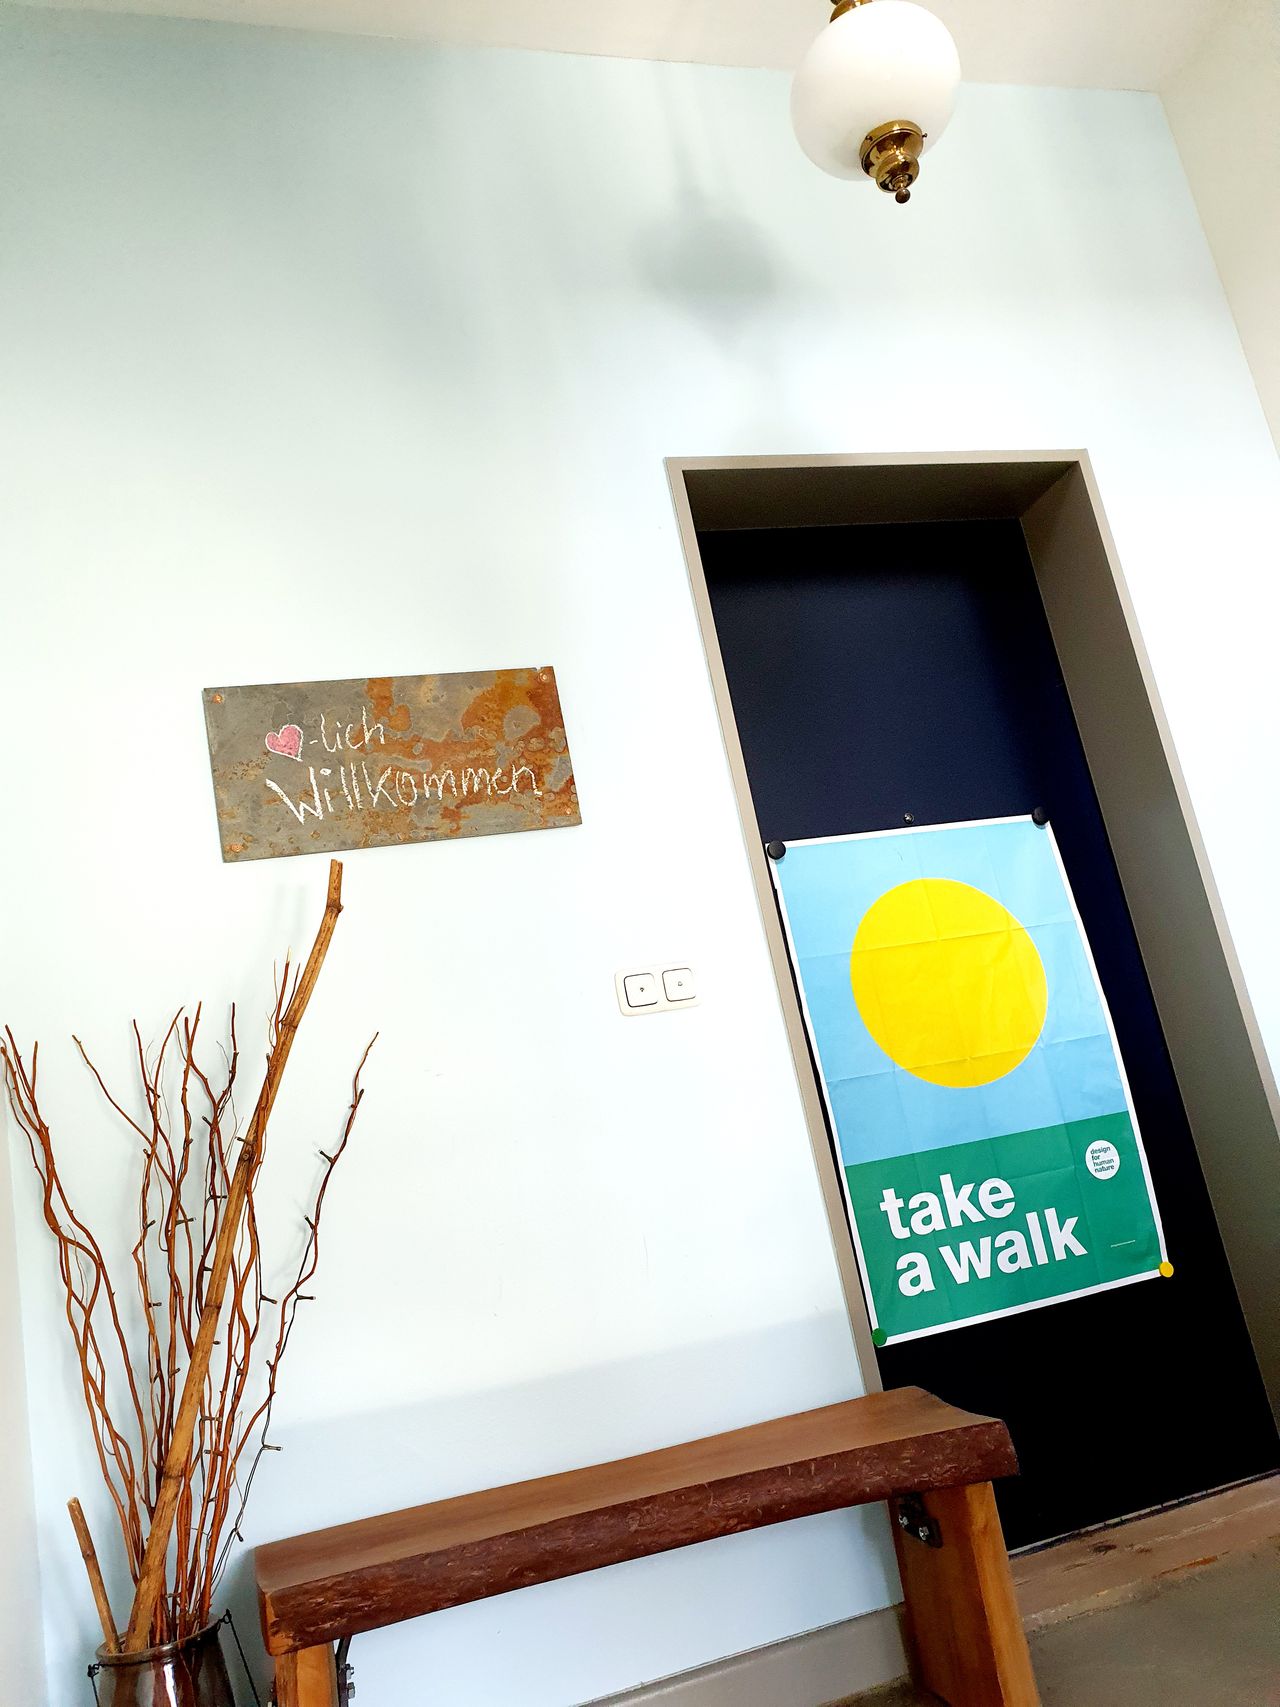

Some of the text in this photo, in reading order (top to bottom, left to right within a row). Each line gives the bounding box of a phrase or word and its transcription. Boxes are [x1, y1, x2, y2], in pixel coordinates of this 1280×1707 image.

[1090, 1146, 1111, 1155] design
[1093, 1158, 1114, 1167] human
[1094, 1165, 1115, 1173] nature
[880, 1173, 1016, 1240] take
[896, 1207, 1088, 1297] a walk
